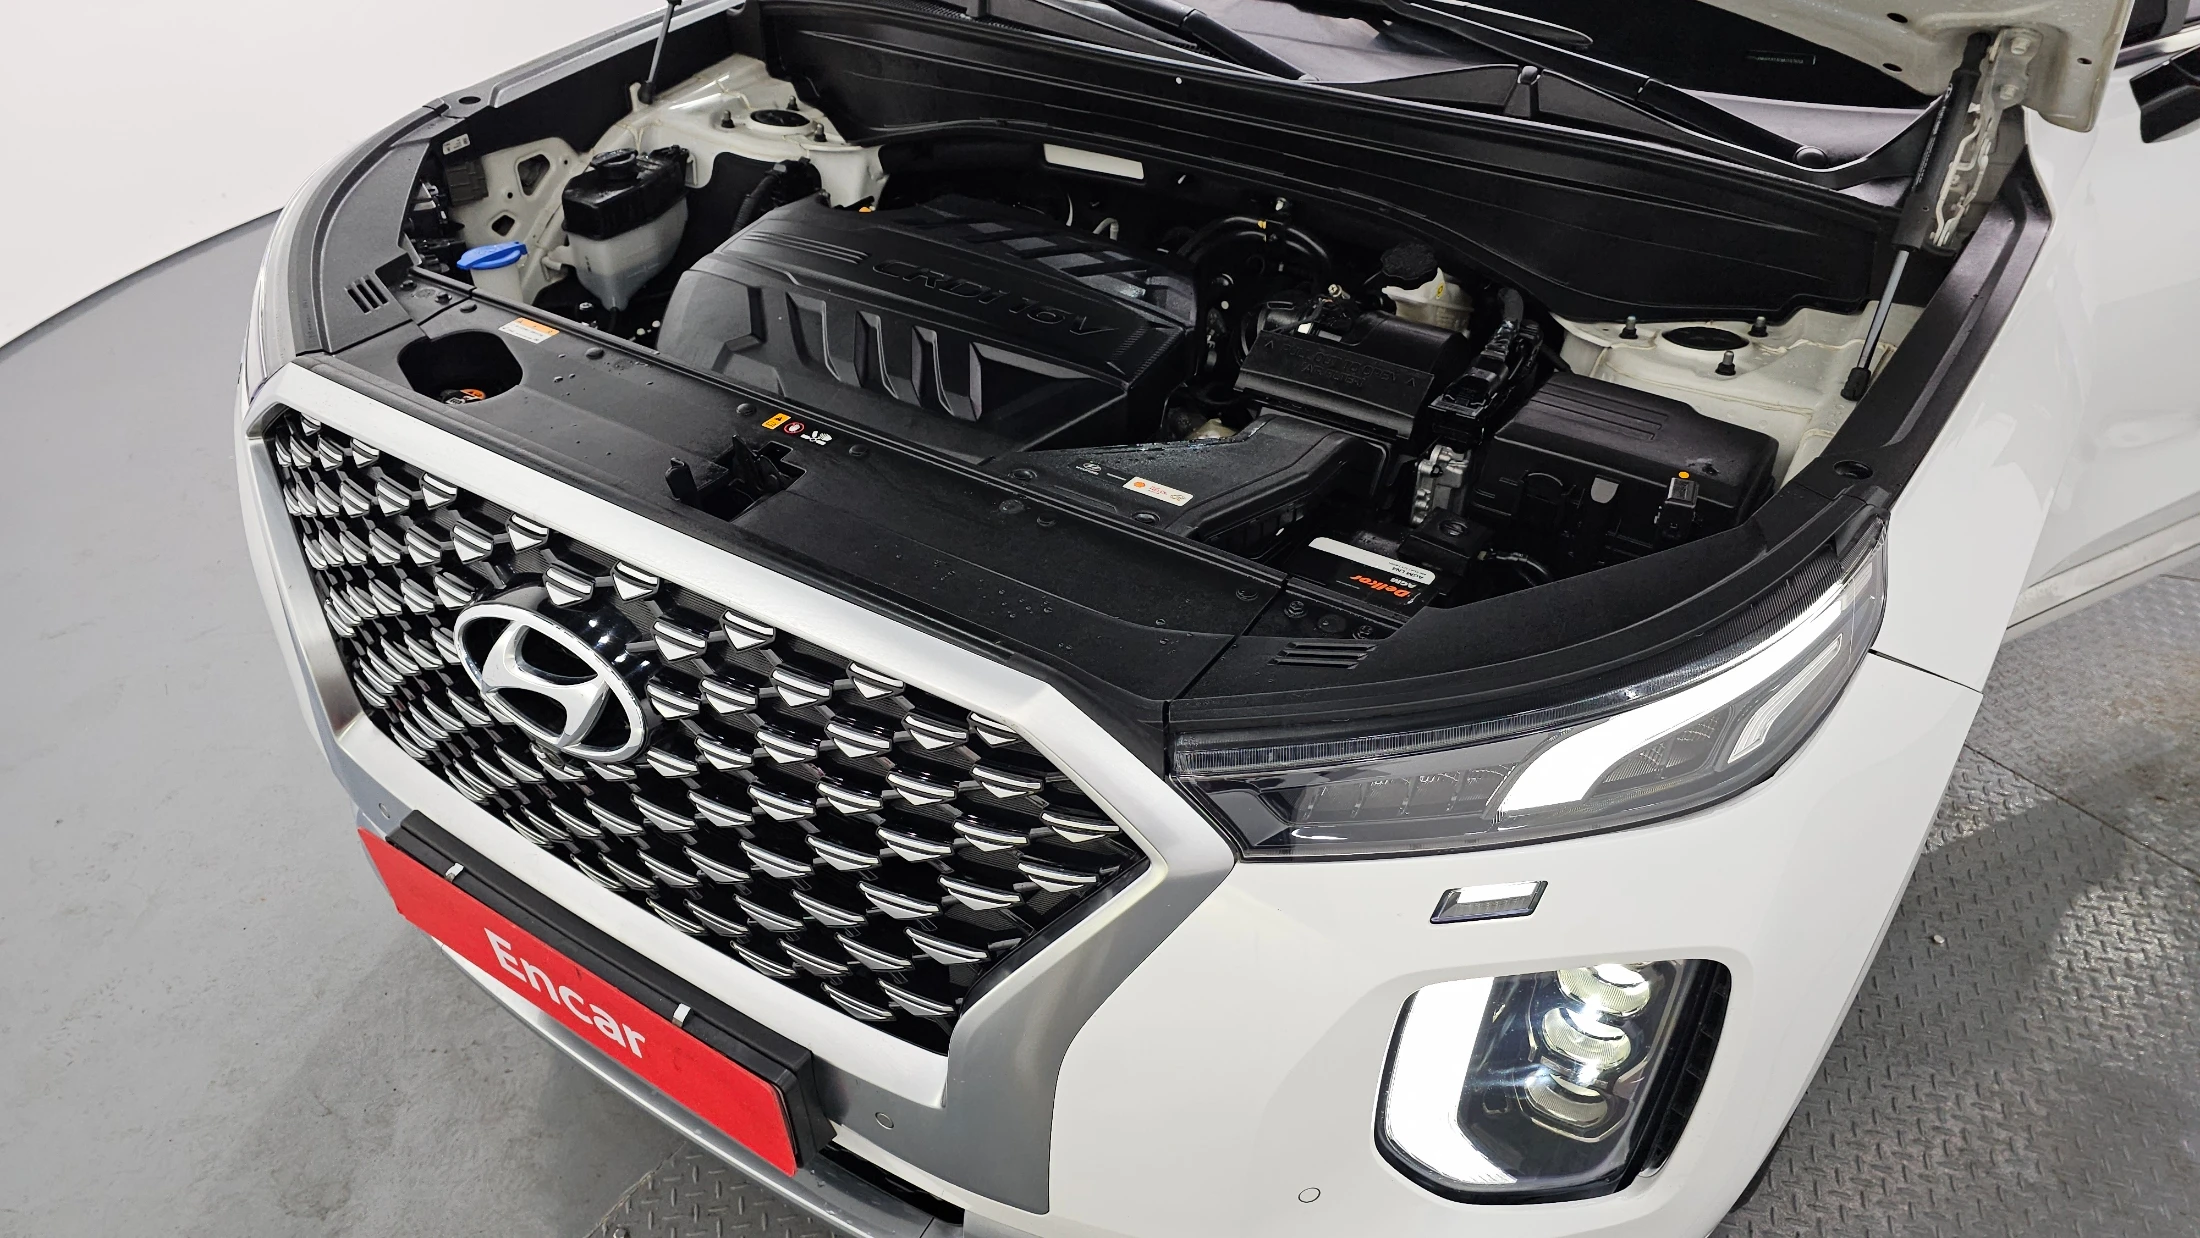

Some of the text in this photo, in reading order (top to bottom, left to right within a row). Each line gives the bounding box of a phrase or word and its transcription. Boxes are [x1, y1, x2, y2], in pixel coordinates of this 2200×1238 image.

[1008, 297, 1119, 336] 16V
[1313, 352, 1342, 368] OUT
[1342, 359, 1362, 373] TO
[1361, 364, 1398, 383] OPEN
[1349, 575, 1411, 598] Delkor
[1390, 577, 1417, 589] AGM
[484, 927, 646, 1059] Encar
